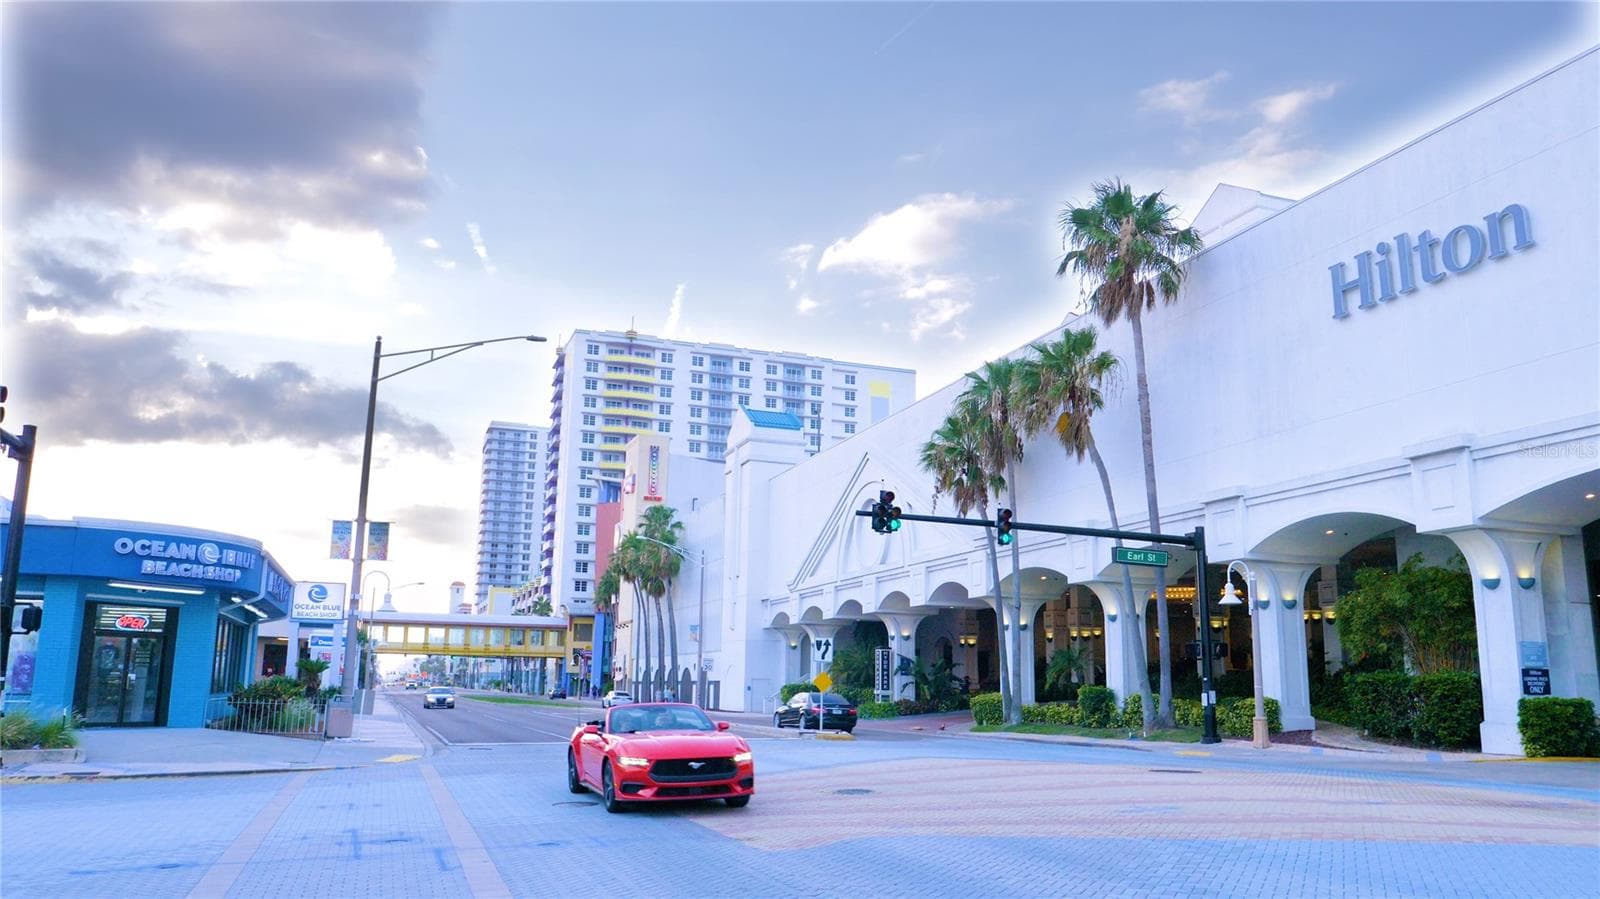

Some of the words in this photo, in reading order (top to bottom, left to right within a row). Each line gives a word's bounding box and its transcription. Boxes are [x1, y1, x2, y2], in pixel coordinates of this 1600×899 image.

[1328, 204, 1535, 319] Hilton
[114, 537, 197, 560] OCEAN
[1127, 551, 1144, 561] Earl
[1147, 553, 1156, 562] St
[141, 560, 201, 577] BEACH
[200, 566, 242, 582] SHOP
[294, 603, 321, 611] OCEAN
[322, 604, 342, 612] BLUE
[118, 616, 146, 629] OPEN
